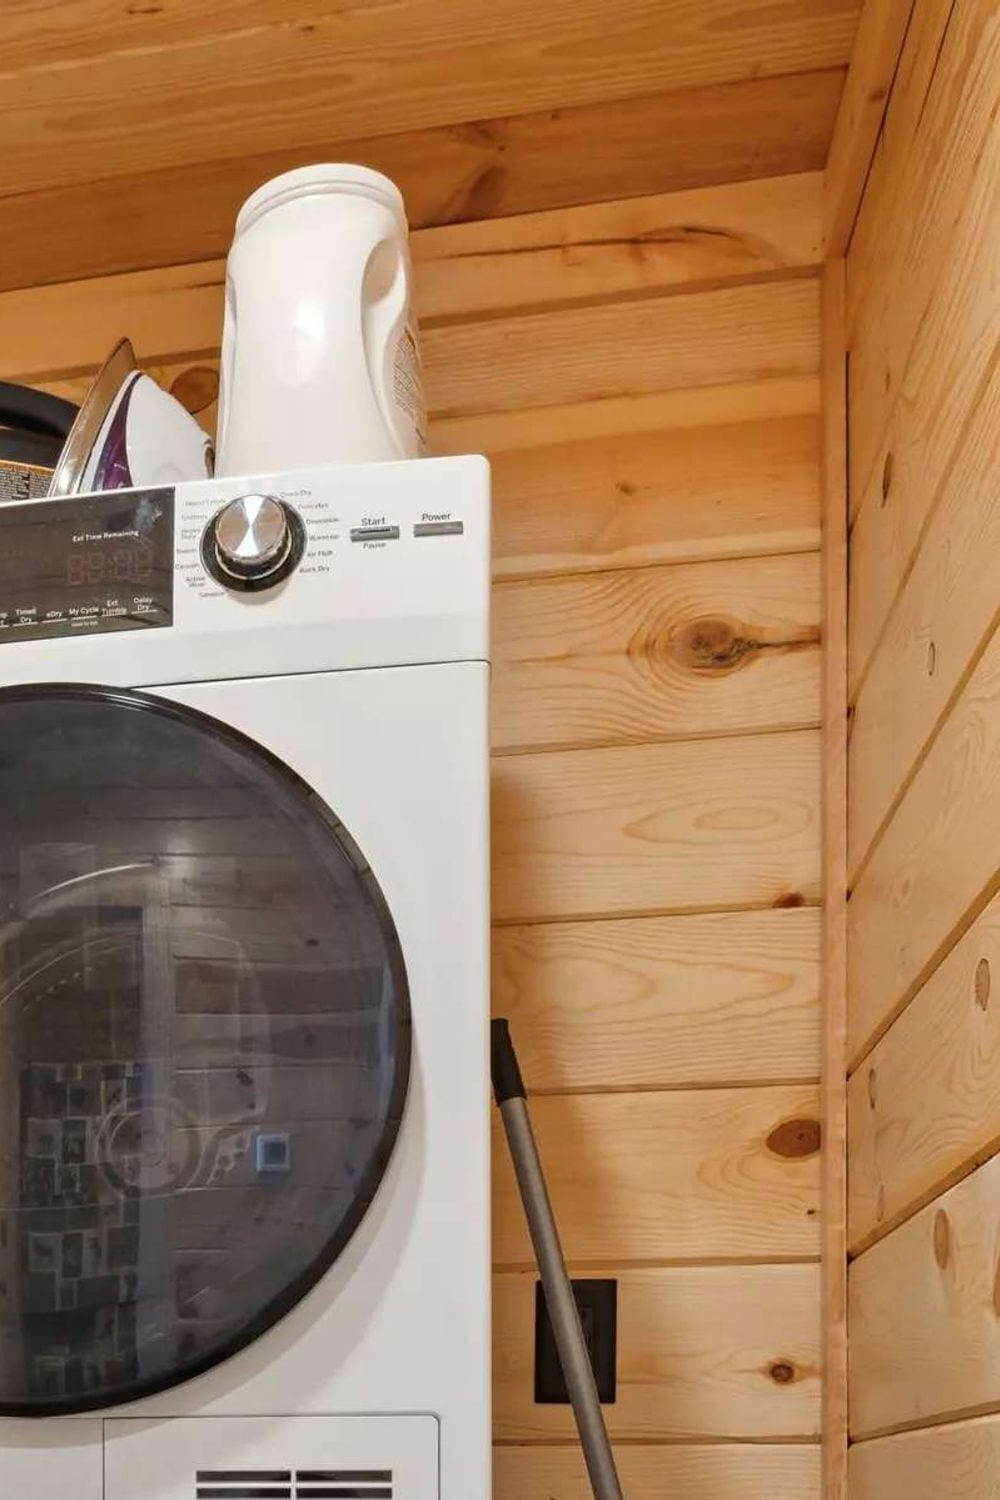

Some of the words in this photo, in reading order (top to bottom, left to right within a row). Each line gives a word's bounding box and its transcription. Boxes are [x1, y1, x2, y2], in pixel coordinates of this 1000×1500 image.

[422, 513, 451, 521] Power
[361, 517, 385, 526] Start
[80, 606, 99, 615] Cycle
[21, 616, 32, 624] Dry
